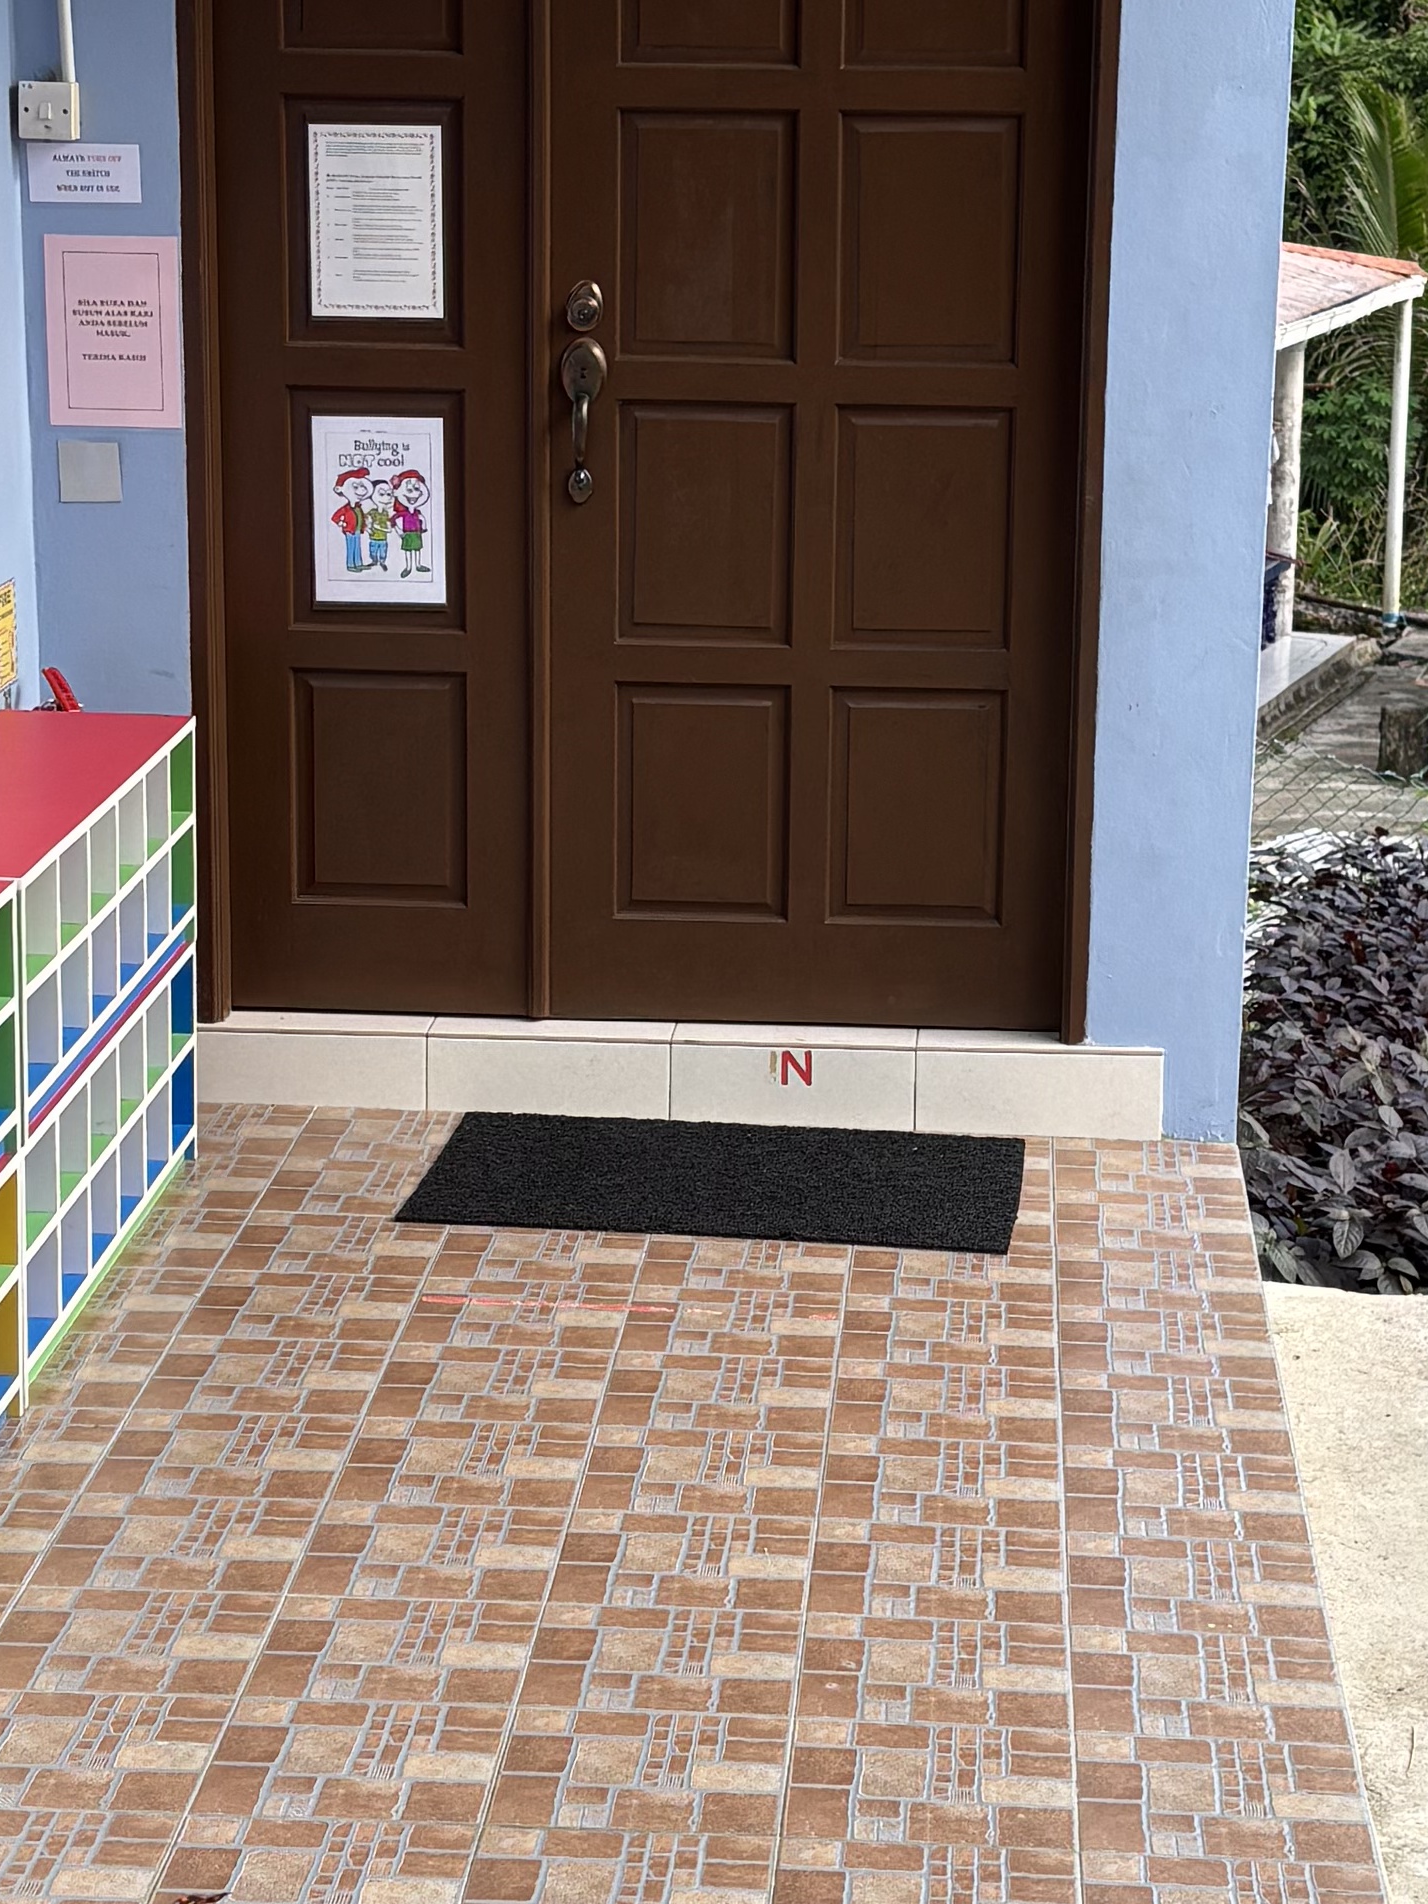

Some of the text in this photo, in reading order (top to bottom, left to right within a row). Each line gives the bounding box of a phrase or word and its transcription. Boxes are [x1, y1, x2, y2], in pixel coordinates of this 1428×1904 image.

[353, 438, 411, 457] Bullying is
[338, 453, 405, 468] NOT cool
